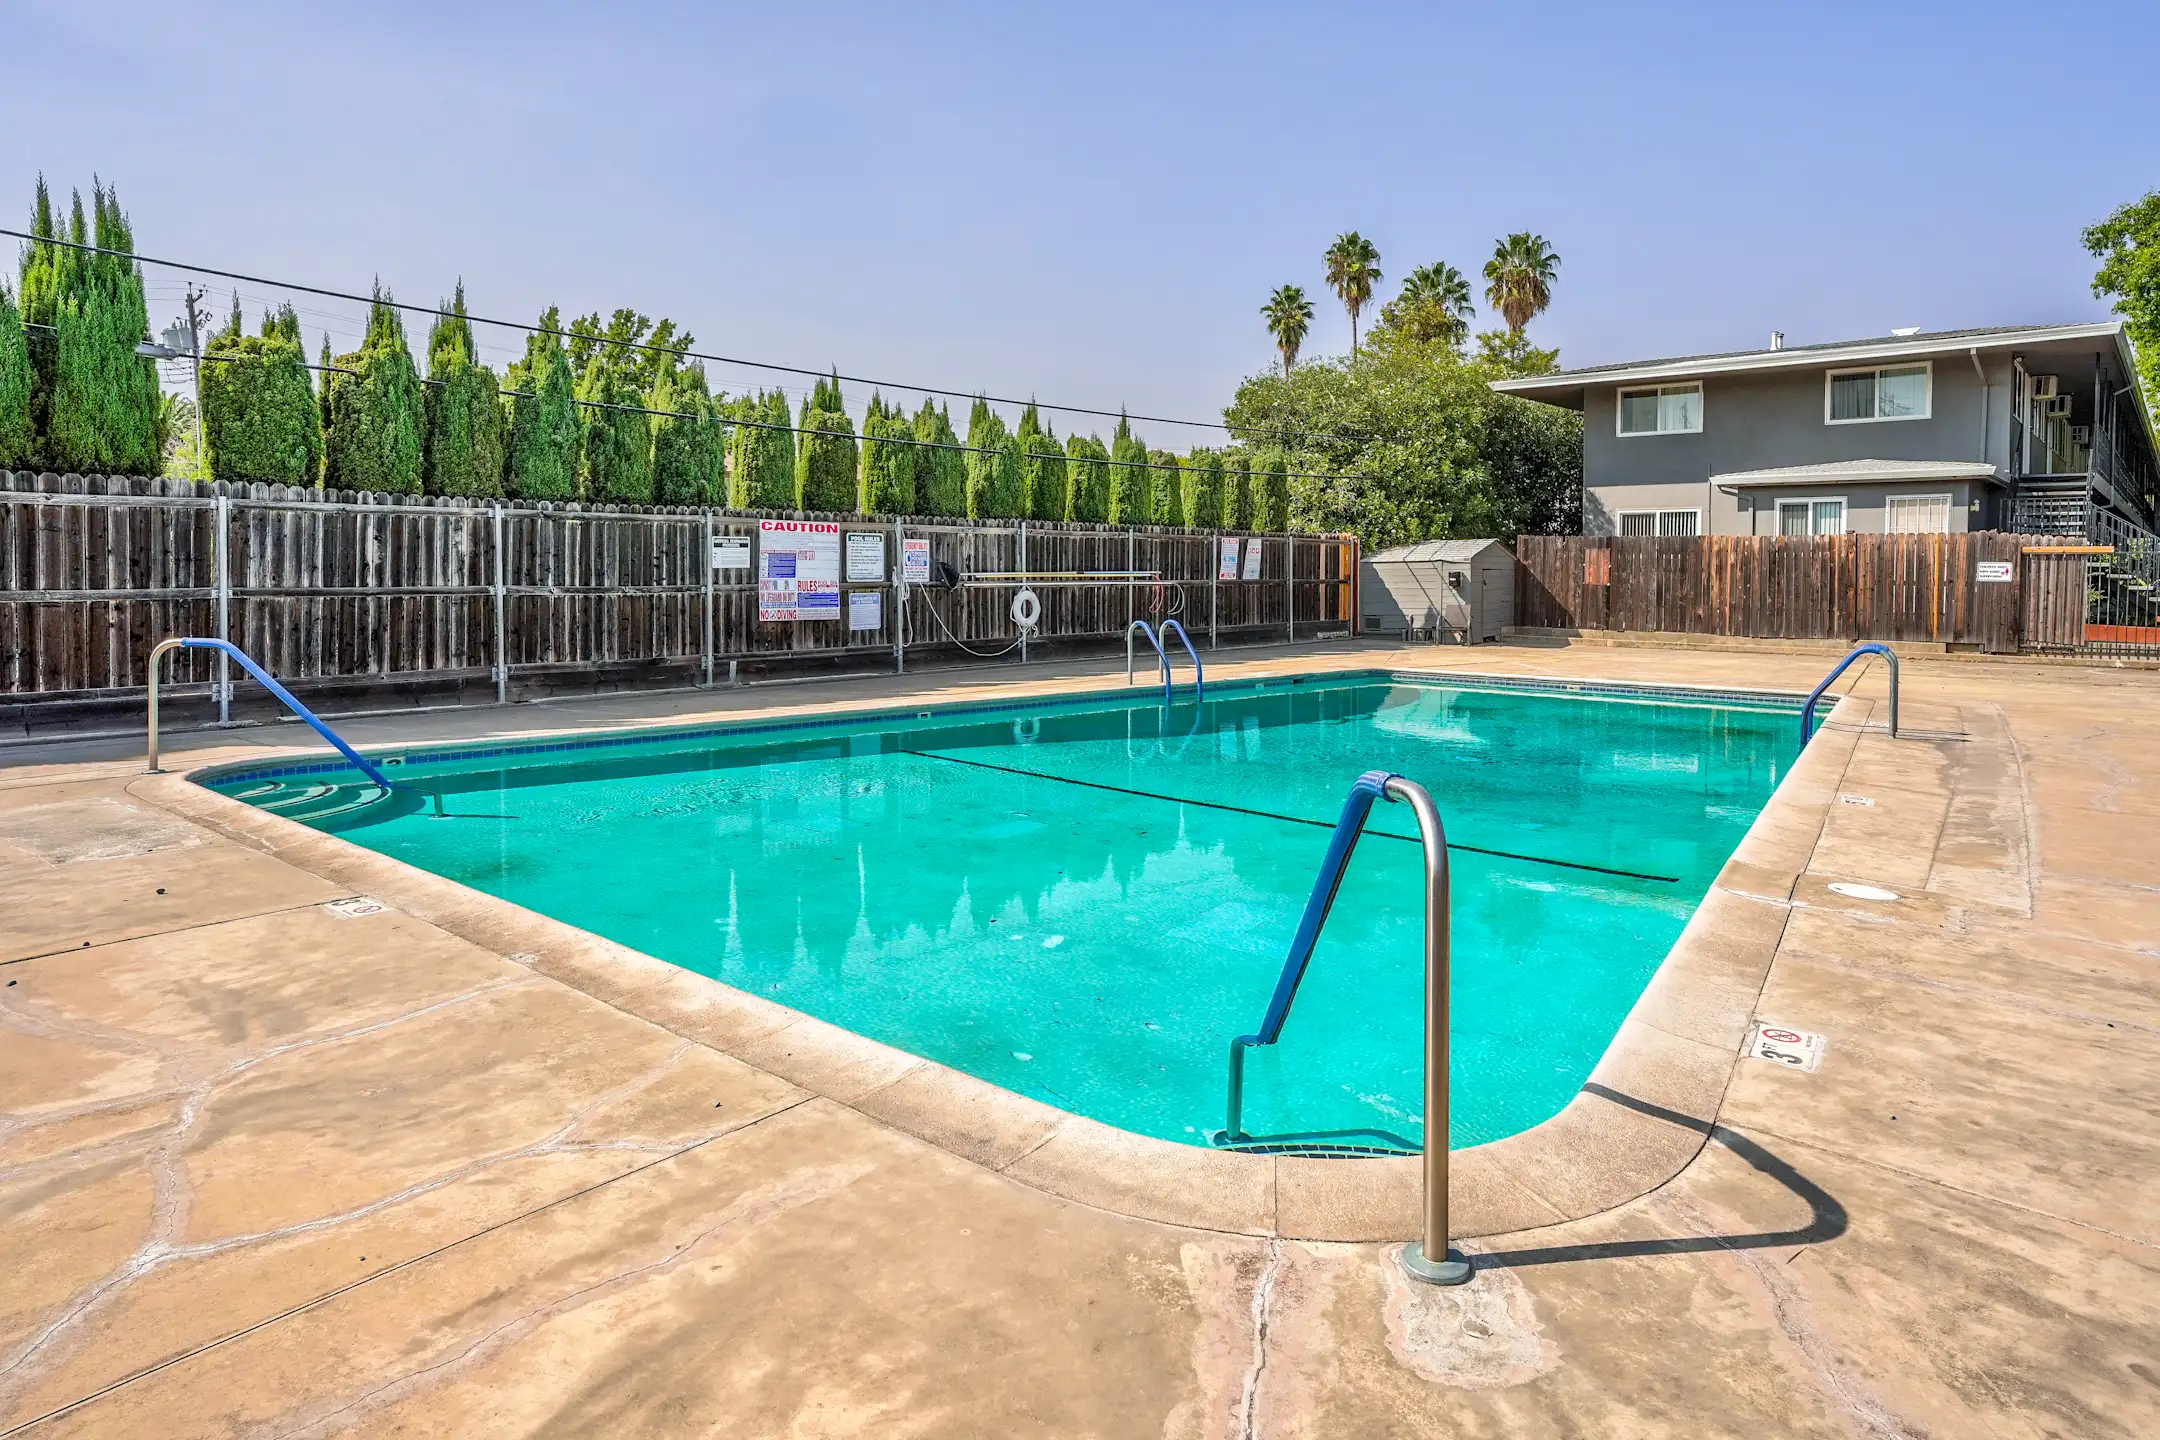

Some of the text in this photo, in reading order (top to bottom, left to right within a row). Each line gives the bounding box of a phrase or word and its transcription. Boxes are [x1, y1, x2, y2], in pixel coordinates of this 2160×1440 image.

[761, 521, 838, 533] CAUTION
[797, 580, 818, 591] RULES
[760, 610, 769, 620] NO
[777, 609, 796, 620] DIVING
[1761, 1050, 1803, 1064] 3
